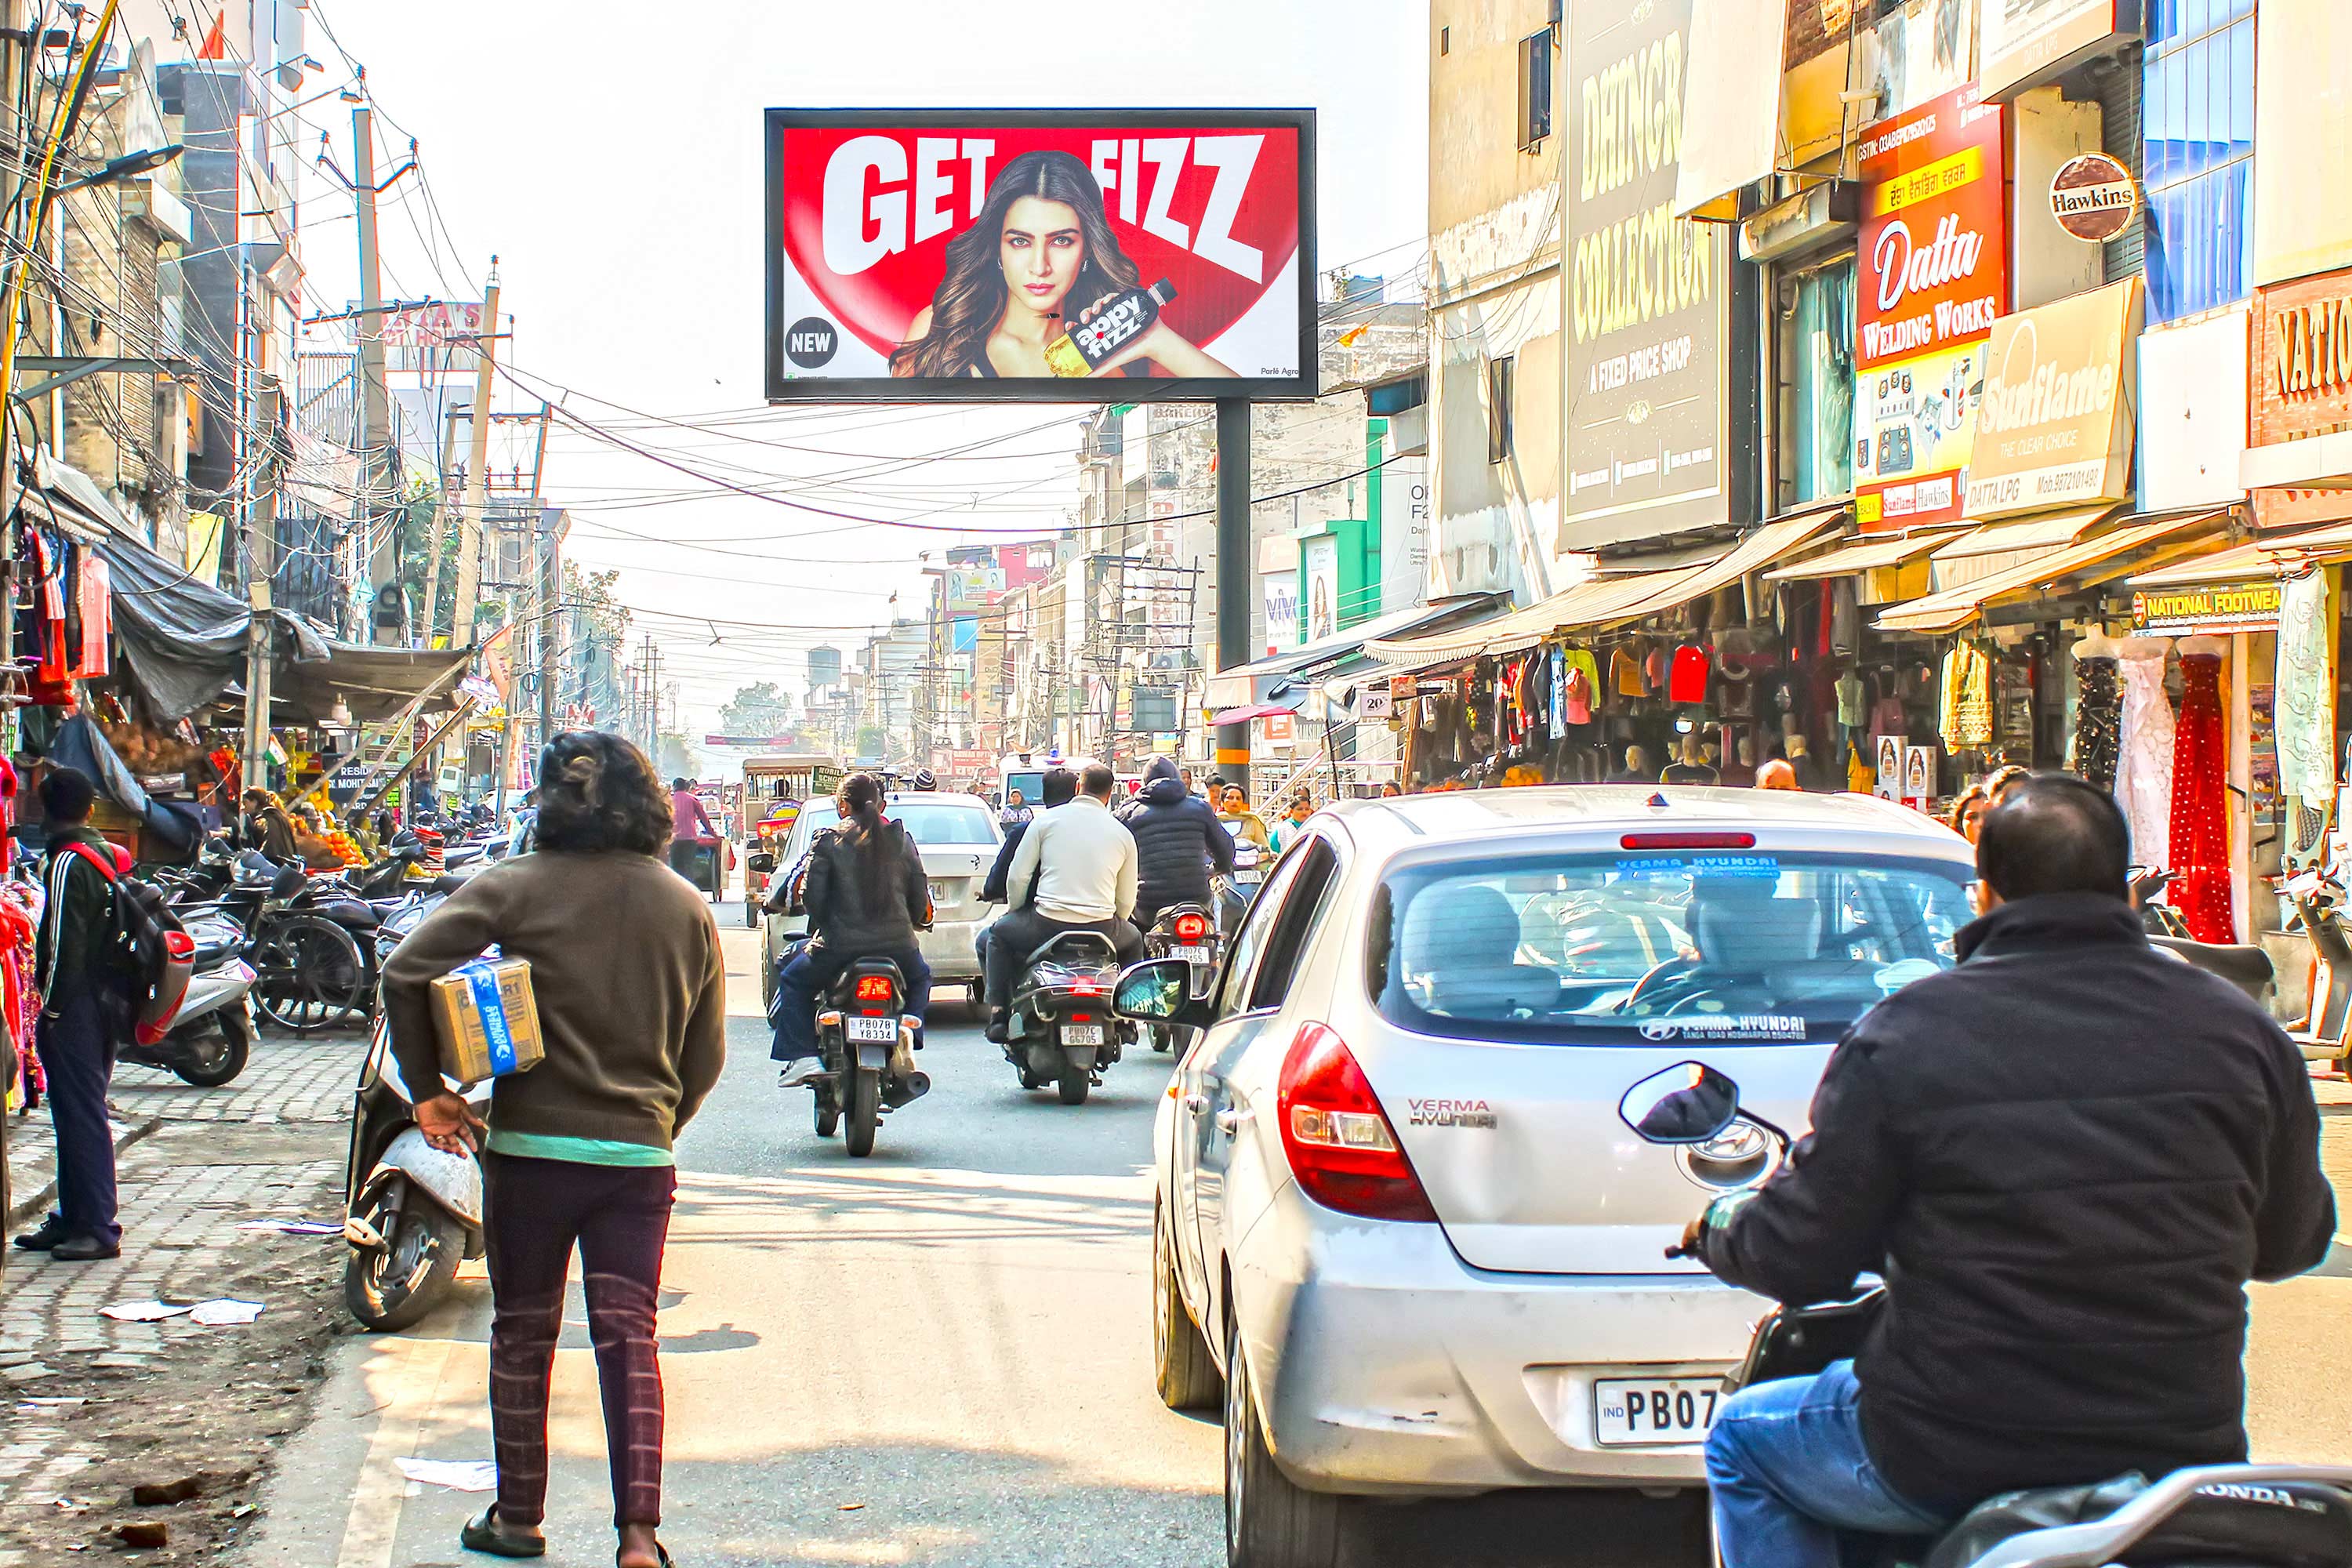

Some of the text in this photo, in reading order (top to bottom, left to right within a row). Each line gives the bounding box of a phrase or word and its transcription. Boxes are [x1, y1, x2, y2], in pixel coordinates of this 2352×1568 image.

[823, 134, 1266, 285] GET FIZZ
[2053, 188, 2132, 214] Hawkins
[1574, 198, 1711, 345] COLLECTION
[1873, 211, 1984, 312] Datta
[1076, 295, 1141, 347] appy
[1863, 295, 1995, 361] WELDING WORKS
[791, 332, 831, 354] NEW
[1087, 316, 1142, 359] fizz
[1261, 367, 1299, 377] Parlé Agro
[1588, 336, 1692, 395] A FIXED PRICE SHOP
[1980, 356, 2114, 436] Sunflame
[2001, 429, 2079, 459] THE CLEAR CHOICE
[1883, 485, 1950, 514] Sunflame Hawkins
[1969, 482, 1998, 509] DATTA
[1999, 477, 2020, 503] LPG
[2147, 594, 2212, 617] NATIONAL
[340, 766, 373, 776] RESID
[1617, 857, 1777, 869] VERMA HYUNDAI
[860, 1029, 891, 1040] Y8334
[1739, 1015, 1806, 1032] HYUNDAI
[1408, 1098, 1490, 1112] VERMA
[1410, 1112, 1497, 1129] HYUNDAI
[1603, 1390, 1718, 1432] IND PB07
[2195, 1484, 2296, 1507] ONDA
